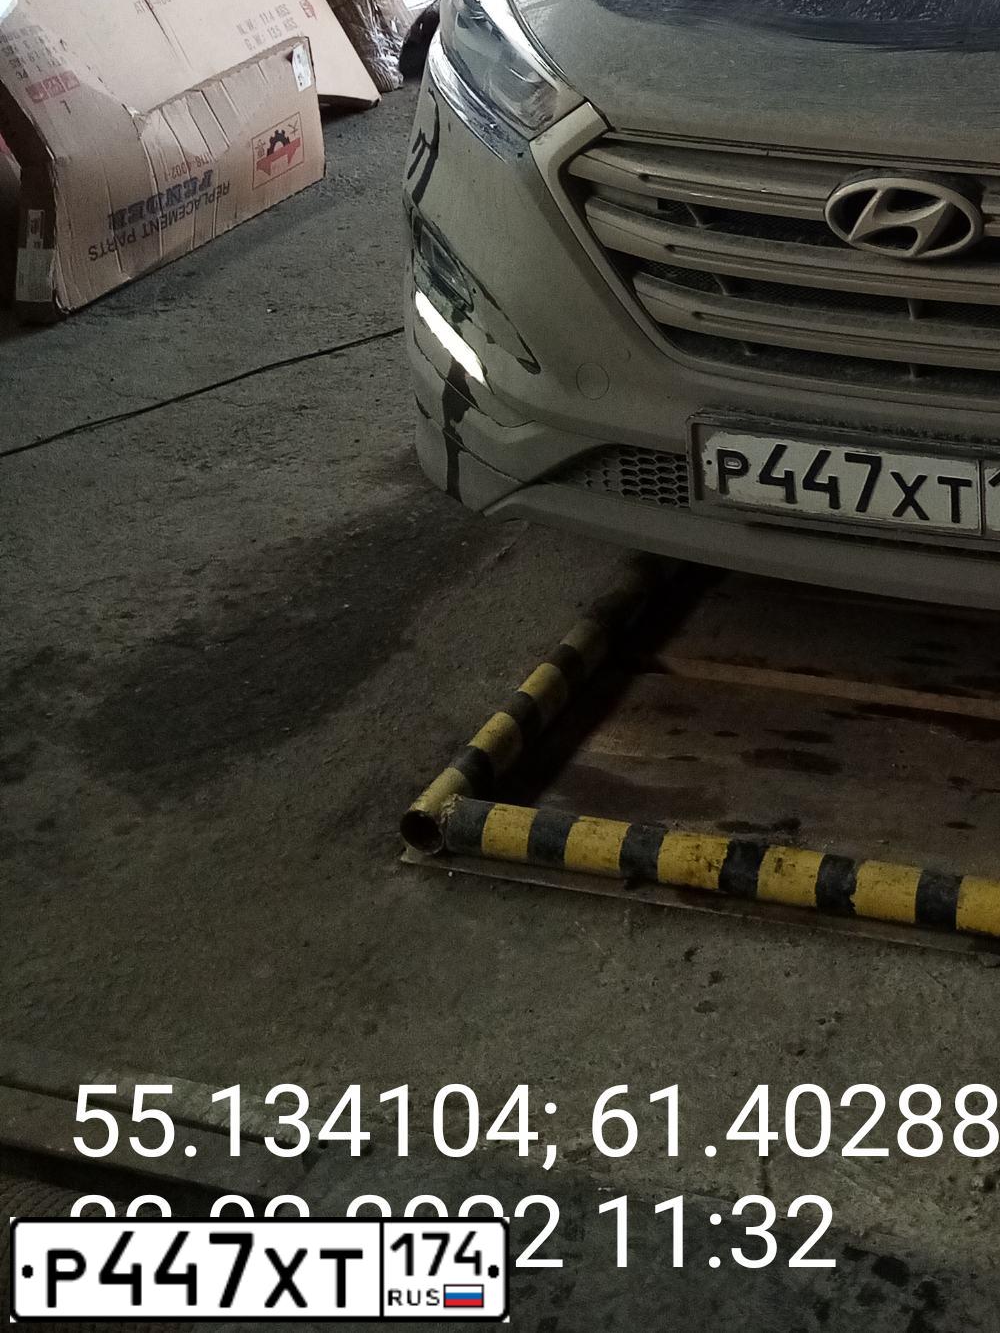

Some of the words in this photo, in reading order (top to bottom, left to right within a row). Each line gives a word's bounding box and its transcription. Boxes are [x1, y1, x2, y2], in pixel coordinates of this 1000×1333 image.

[108, 168, 214, 231] FENDER
[142, 179, 231, 240] REPLACEMENT
[88, 231, 138, 263] PARTS
